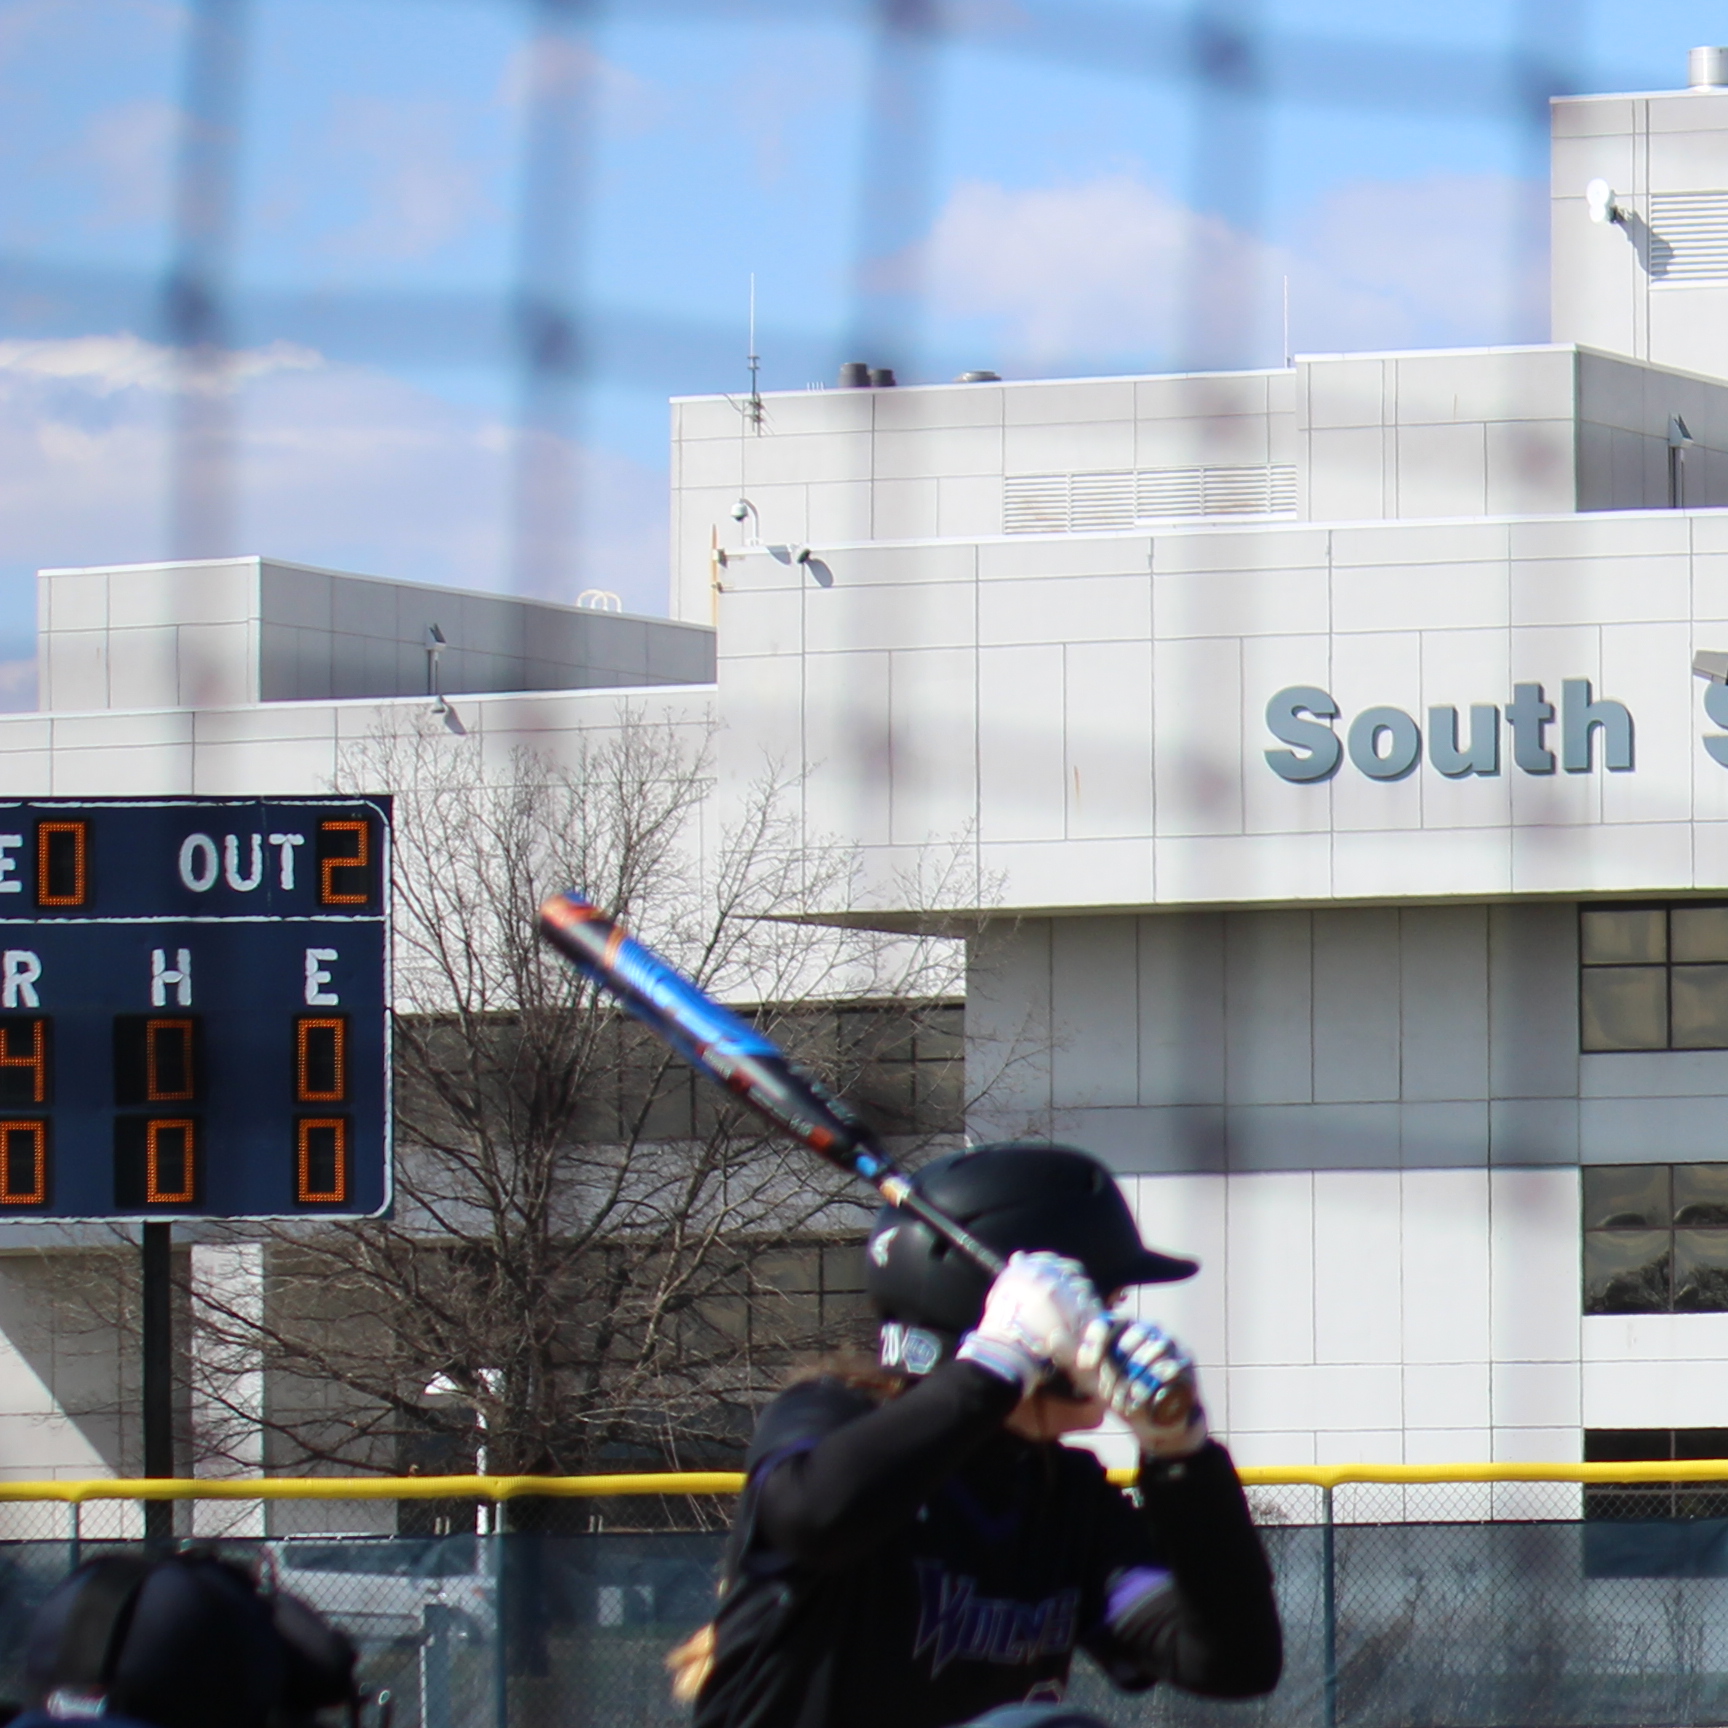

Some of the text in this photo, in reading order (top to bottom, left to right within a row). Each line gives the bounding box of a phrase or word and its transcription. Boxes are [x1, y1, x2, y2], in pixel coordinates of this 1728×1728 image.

[1263, 678, 1636, 784] South
[38, 821, 85, 905] 0
[179, 832, 304, 892] OUT
[321, 820, 368, 904] 2
[2, 948, 339, 1008] R H E
[147, 1019, 193, 1101] 0
[298, 1018, 344, 1101] 0
[147, 1119, 193, 1203] 0
[298, 1118, 344, 1202] 0
